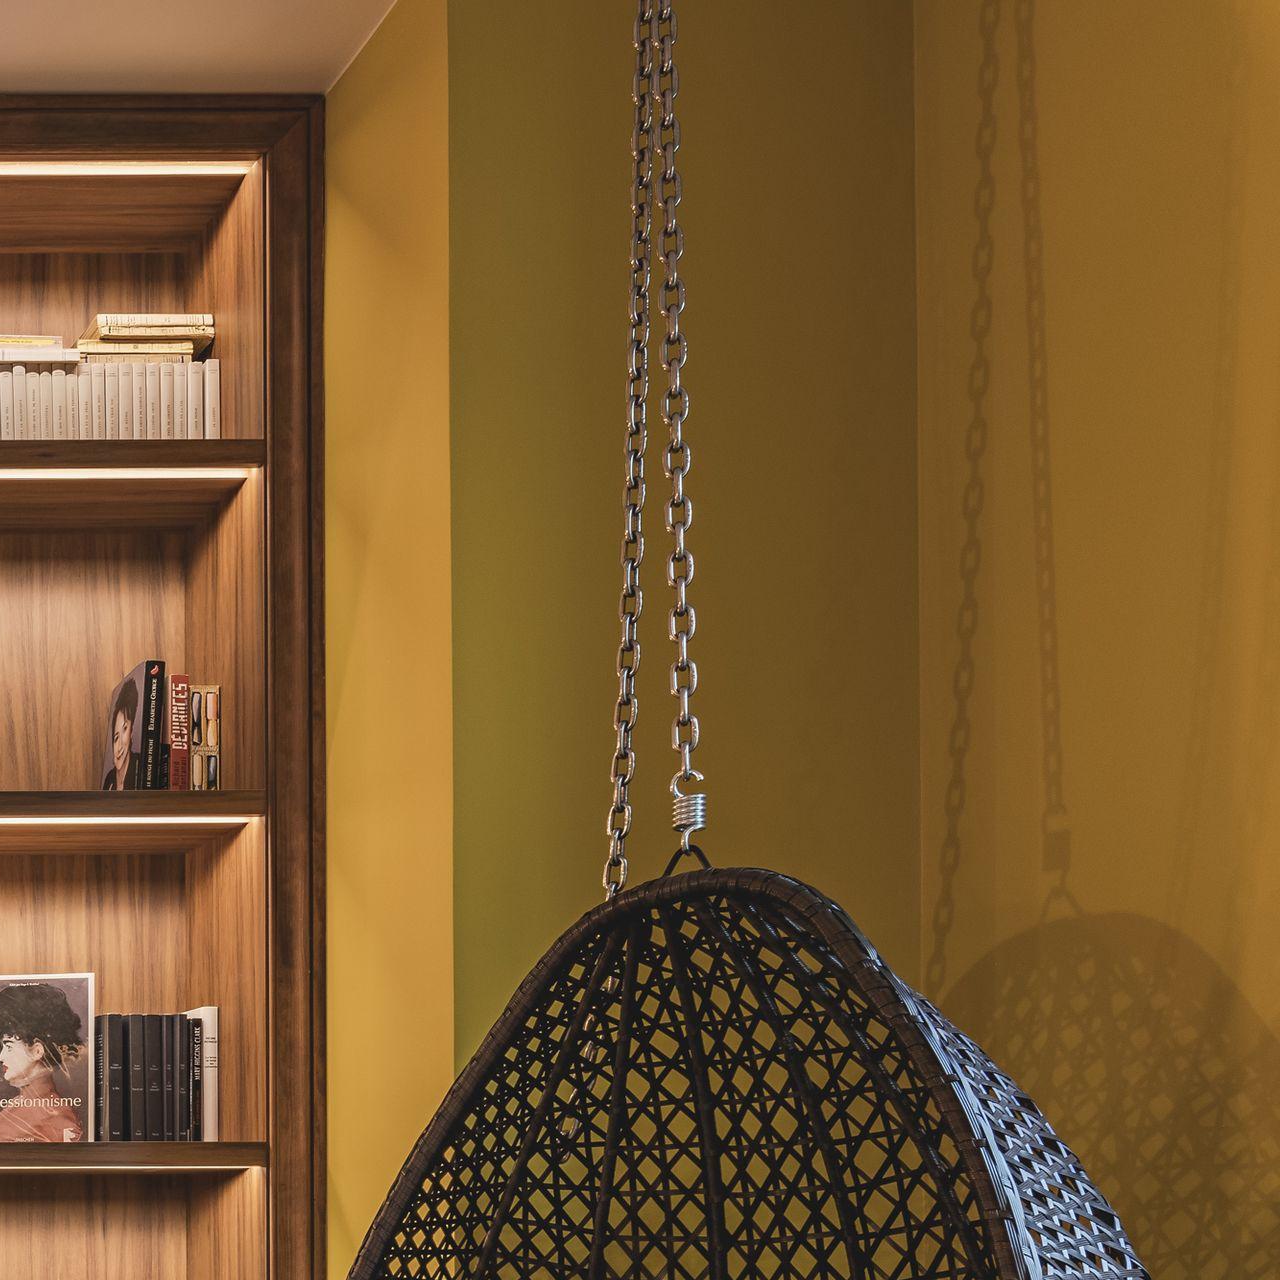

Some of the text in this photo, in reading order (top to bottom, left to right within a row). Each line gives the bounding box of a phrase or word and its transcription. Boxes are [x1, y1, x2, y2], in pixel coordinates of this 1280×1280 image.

[148, 678, 158, 731] ELIZABETH GEORGE
[171, 683, 188, 750] DÉVIANCES
